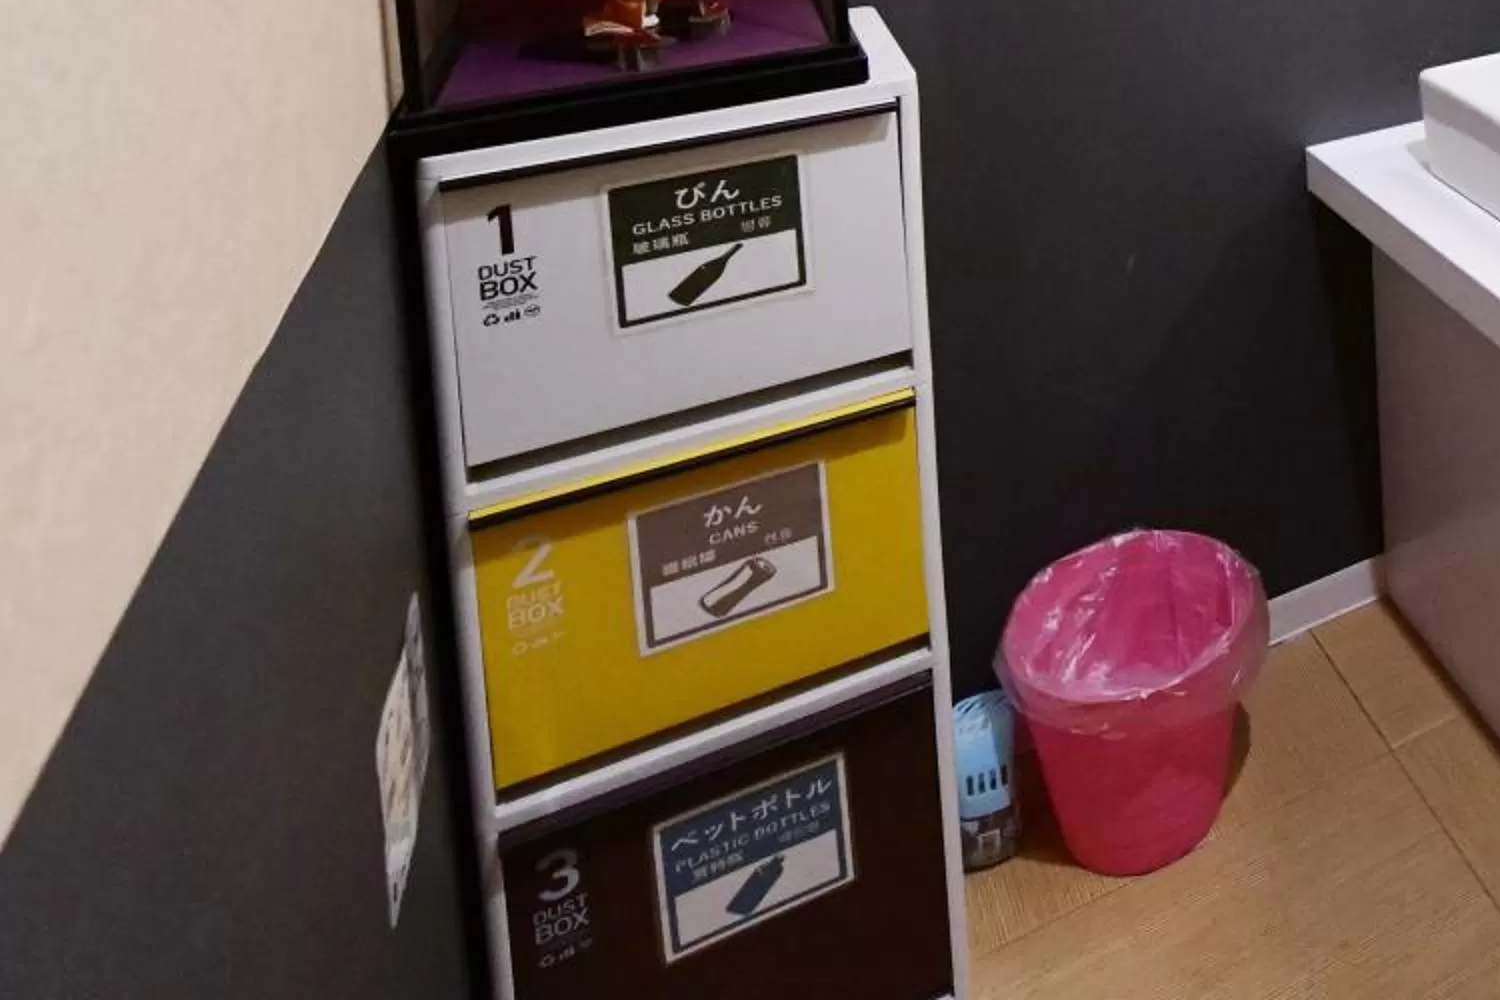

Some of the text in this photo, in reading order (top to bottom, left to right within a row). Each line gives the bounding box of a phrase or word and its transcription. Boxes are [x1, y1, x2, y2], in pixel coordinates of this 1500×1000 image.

[674, 179, 741, 210] びん
[486, 203, 515, 256] 1
[632, 194, 783, 236] GLASS BOTTLES
[478, 255, 538, 281] DUST
[480, 271, 538, 301] BOX
[703, 495, 764, 528] かん
[708, 521, 761, 546] CANS
[511, 533, 556, 590] 2
[508, 595, 565, 631] BOX
[675, 834, 750, 873] PLASTIC
[754, 801, 832, 841] BOTTLES
[535, 849, 580, 901] 3
[532, 892, 590, 926] DUST
[535, 907, 590, 945] BOX
